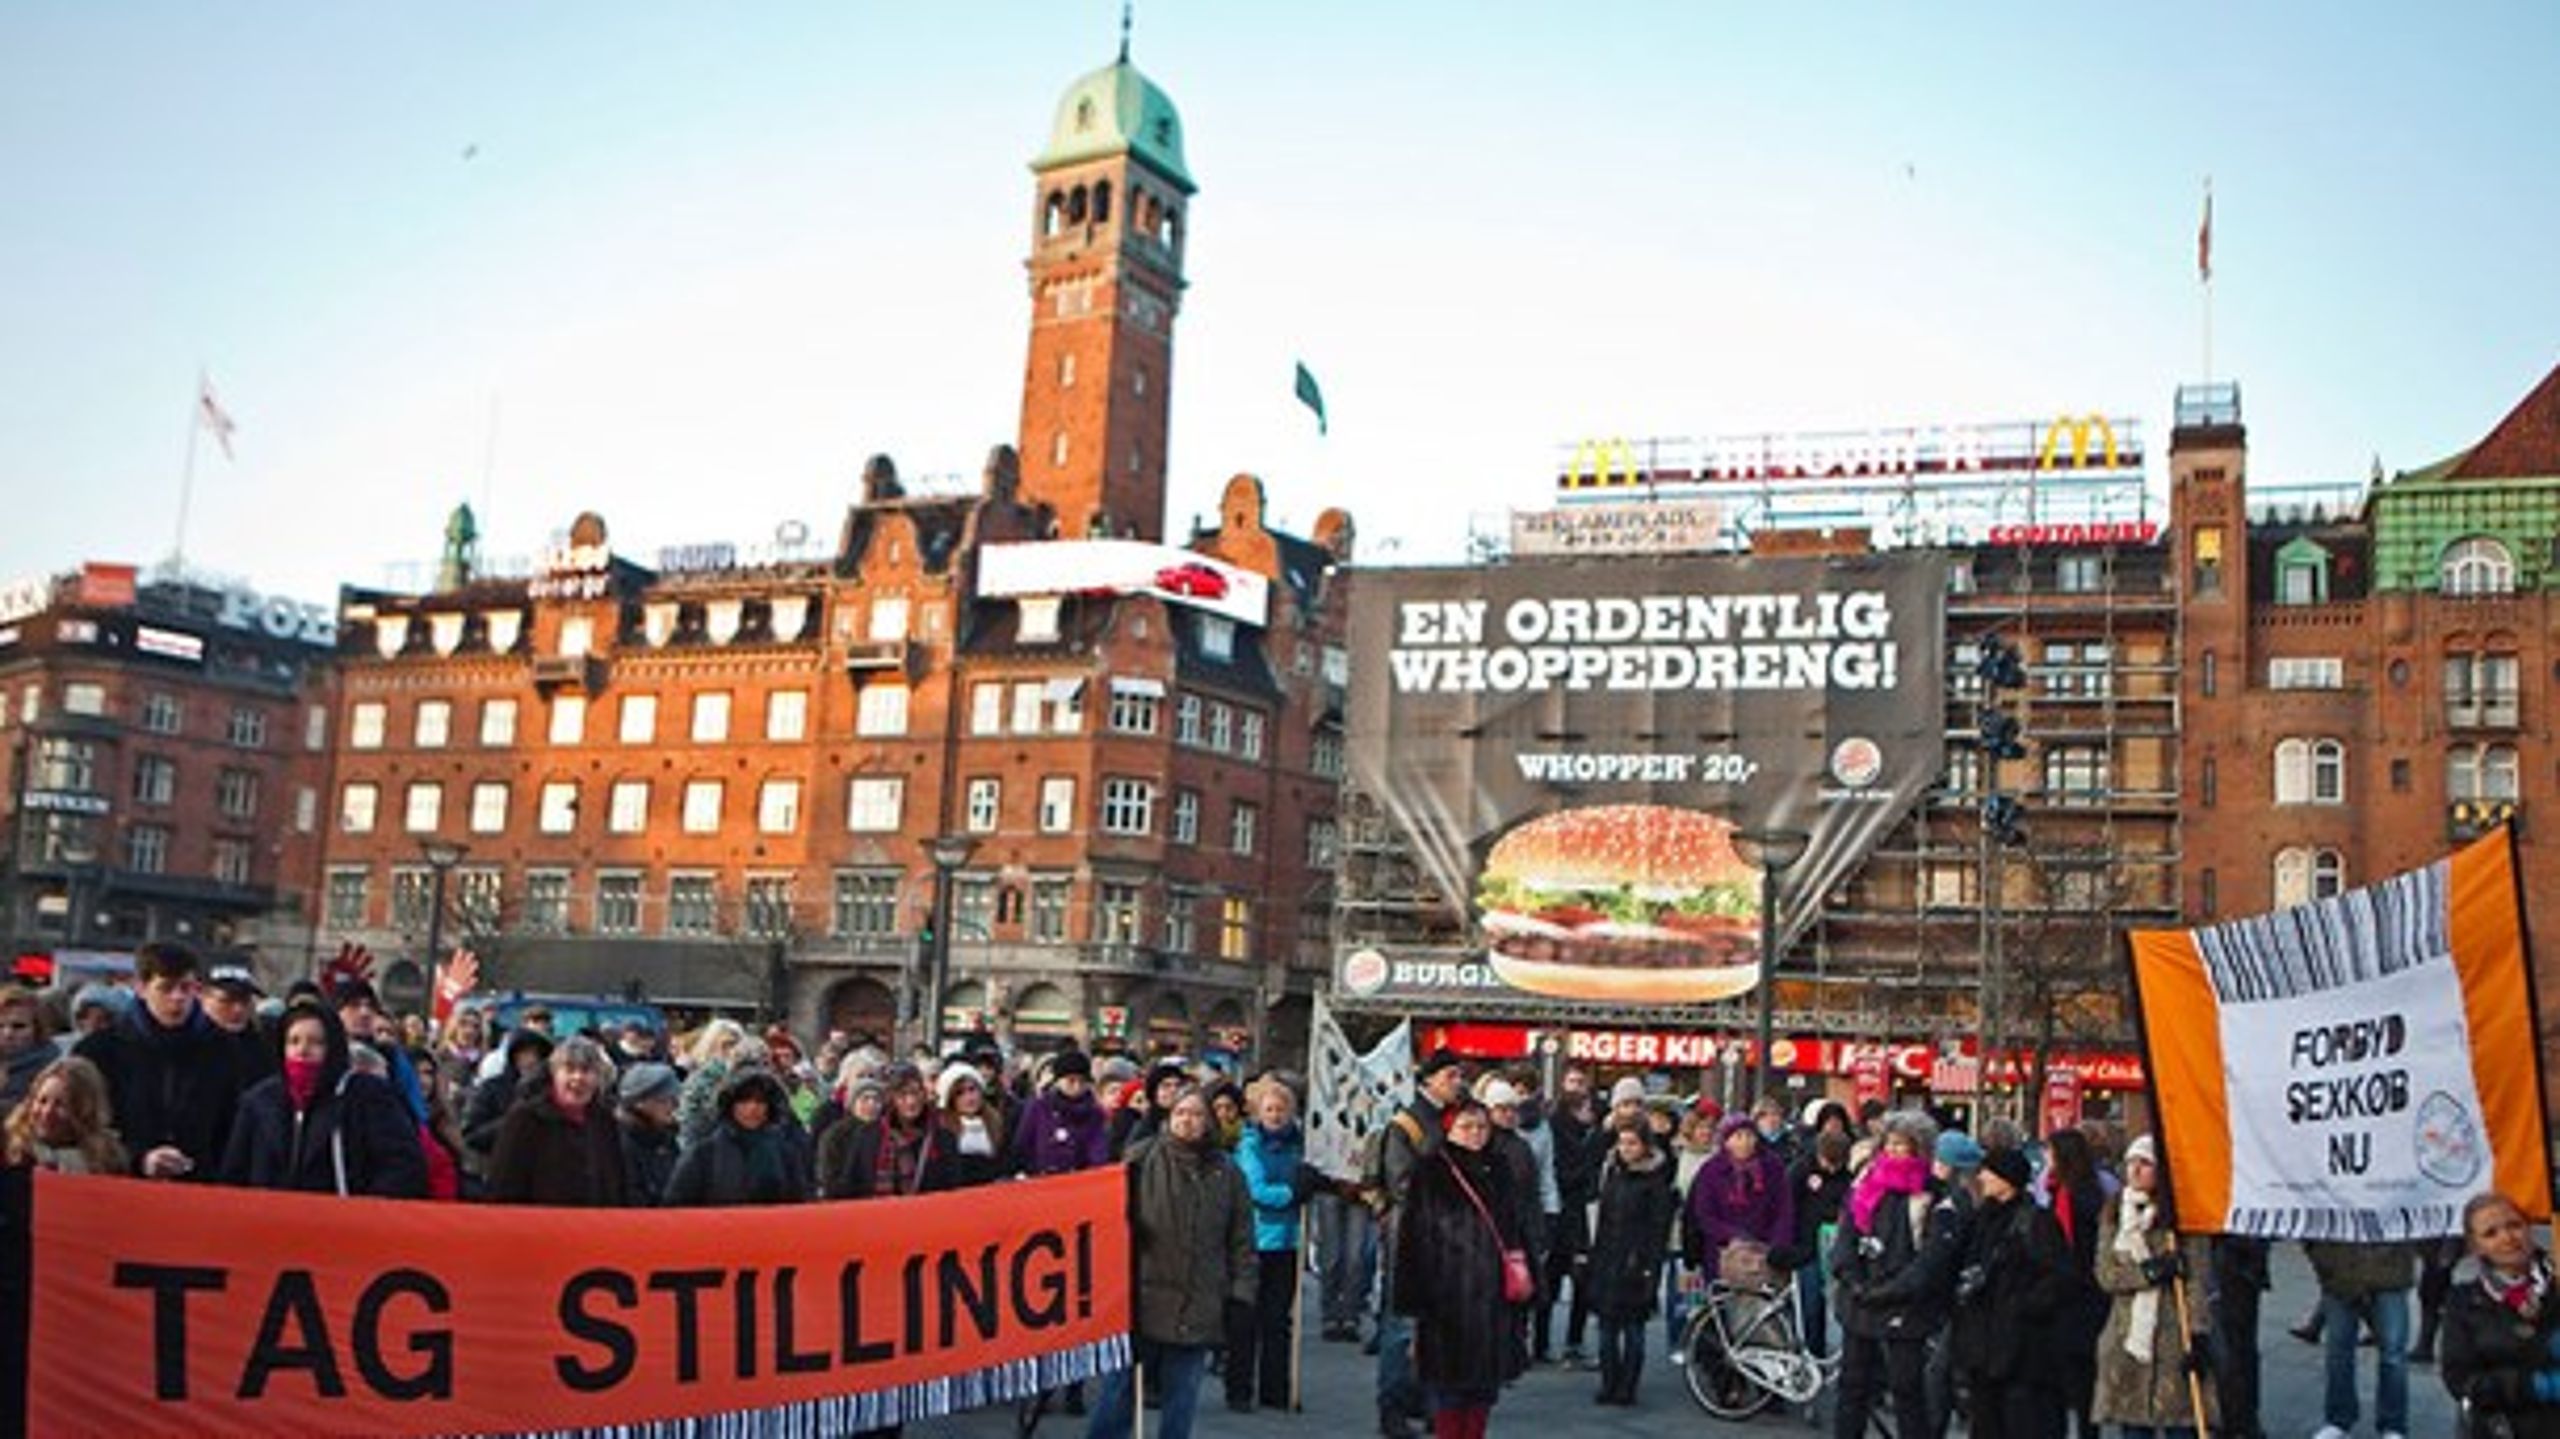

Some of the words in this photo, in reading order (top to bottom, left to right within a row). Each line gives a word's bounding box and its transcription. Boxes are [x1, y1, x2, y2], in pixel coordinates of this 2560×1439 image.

[1401, 601, 1487, 644] EN
[1506, 592, 1891, 642] ORDENTLIG
[1389, 643, 1897, 692] WHOPPEDRENG!
[1838, 1044, 1928, 1077] KC
[2291, 1013, 2407, 1069] FORBYD
[2286, 1068, 2411, 1125] SEXKØB
[2327, 1131, 2371, 1177] NU
[110, 1260, 455, 1403] TAG
[553, 1223, 1093, 1394] STILLING!
